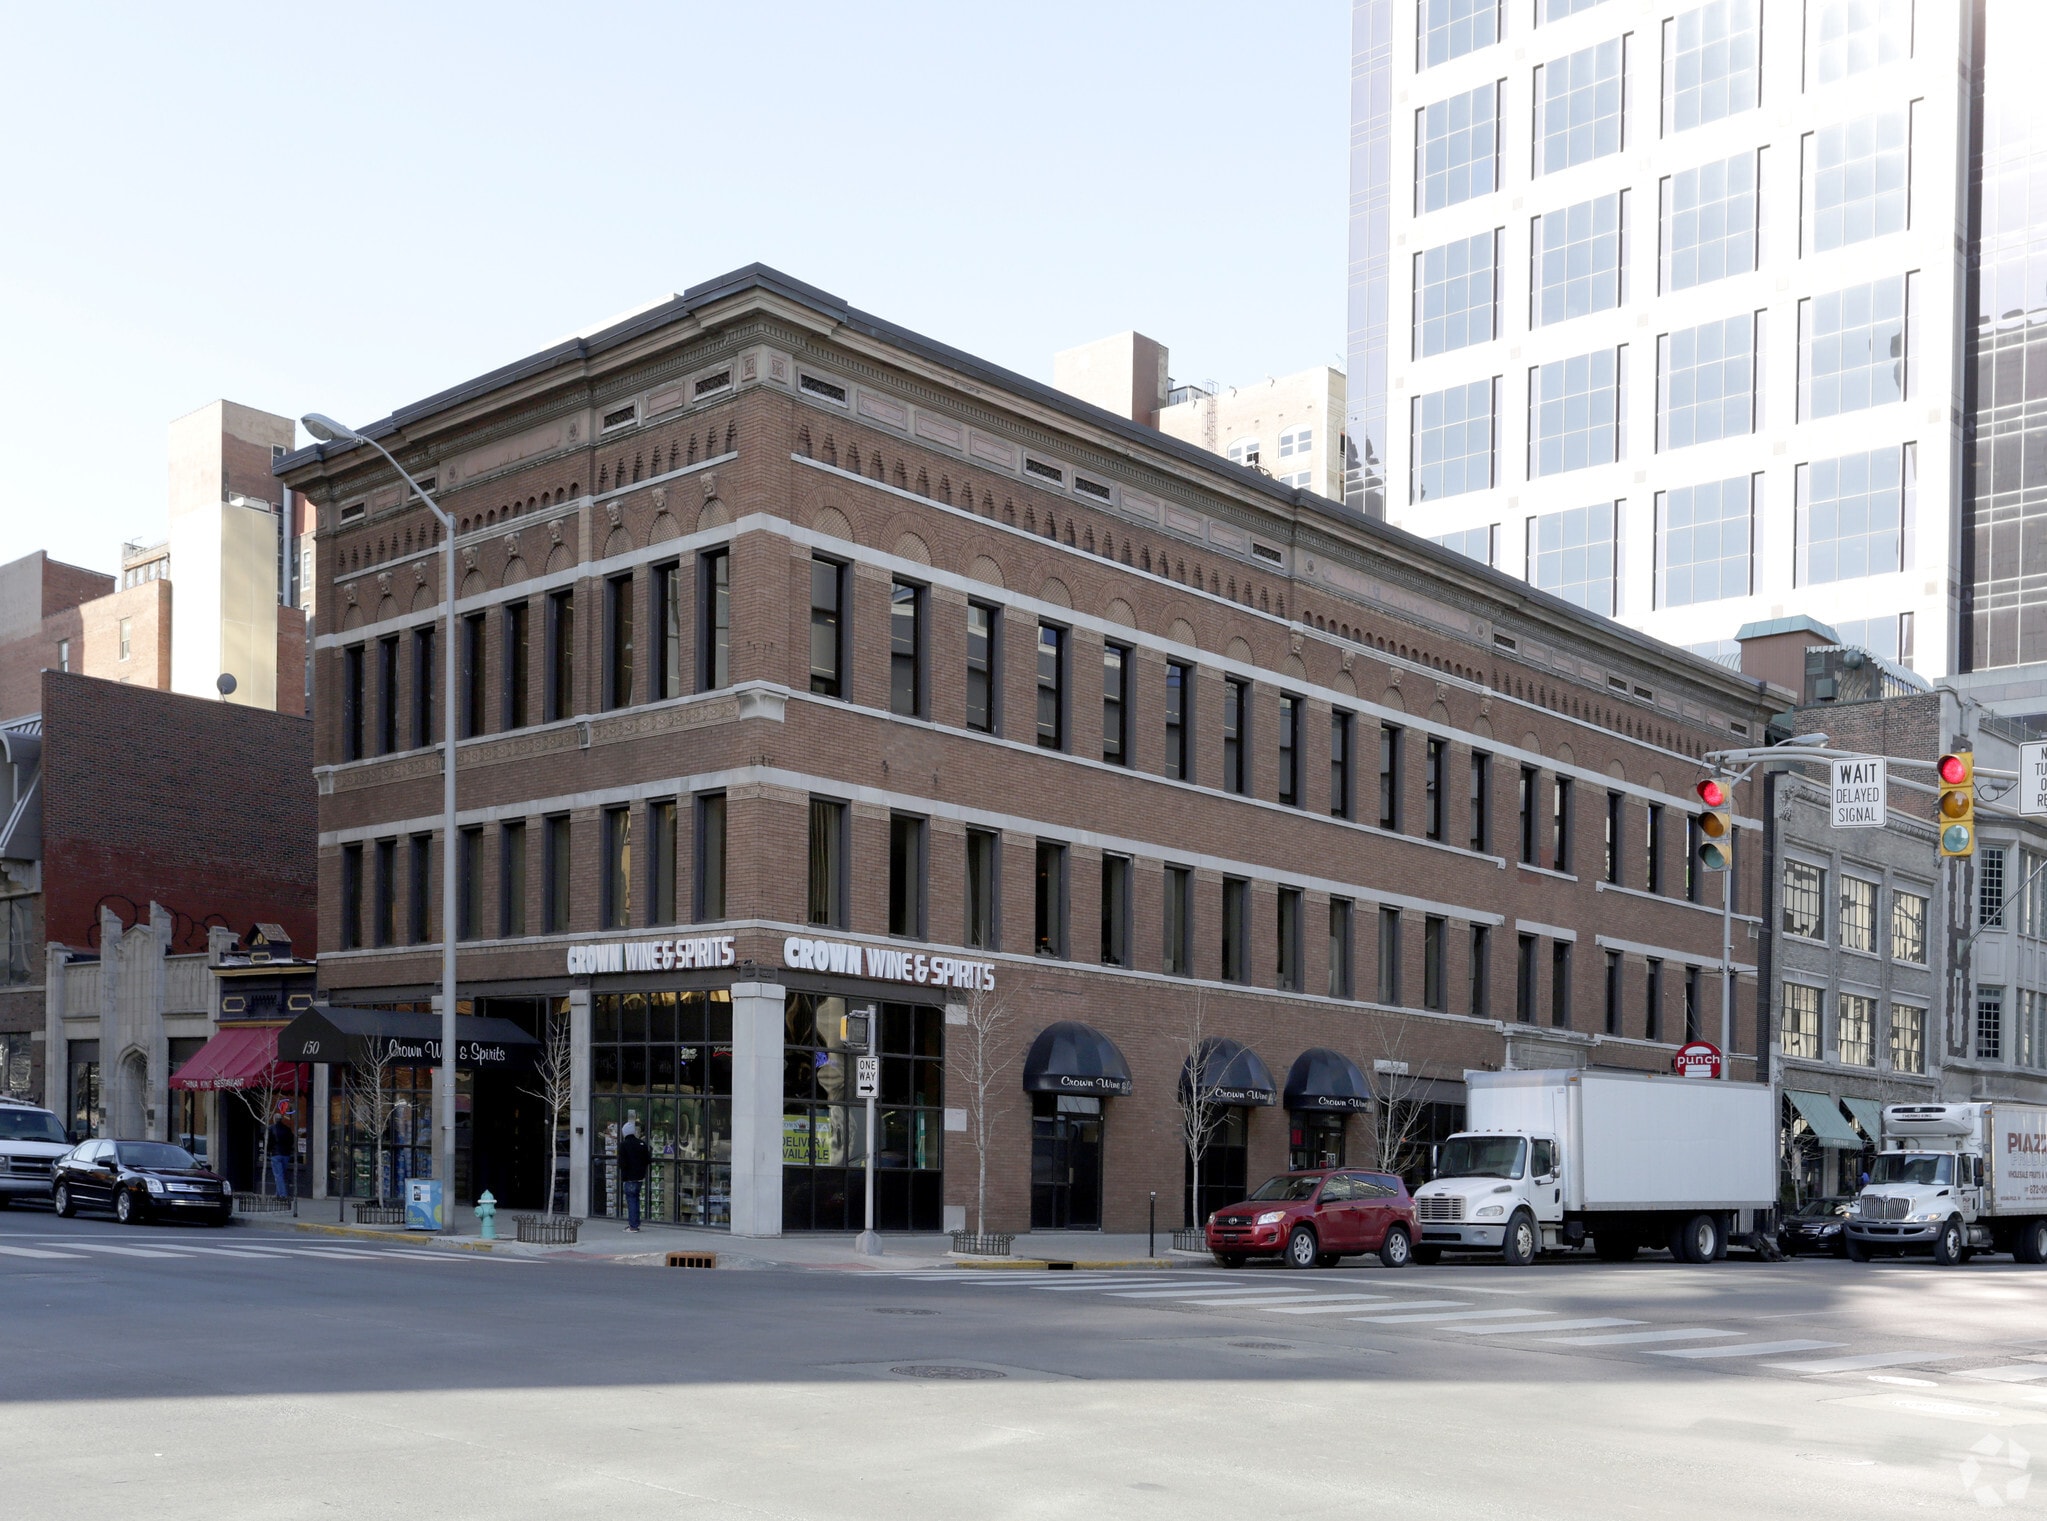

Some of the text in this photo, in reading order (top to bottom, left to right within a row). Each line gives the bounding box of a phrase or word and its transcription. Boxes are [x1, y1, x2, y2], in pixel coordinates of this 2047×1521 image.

[1840, 763, 1877, 784] WAIT
[1836, 787, 1880, 804] DELAYED
[1838, 807, 1877, 822] SIGNAL
[567, 943, 624, 975] CROWN
[784, 936, 862, 975] CROWN
[302, 1040, 320, 1055] 150
[388, 1038, 422, 1058] Crown
[459, 1049, 467, 1060] &
[470, 1042, 505, 1066] Spirits
[859, 1060, 876, 1070] ONE
[1677, 1054, 1720, 1068] punch
[859, 1072, 876, 1081] WAY
[1061, 1076, 1094, 1087] Crown
[1096, 1077, 1120, 1089] Wine
[1214, 1087, 1245, 1099] Crown
[1318, 1096, 1346, 1107] Crown
